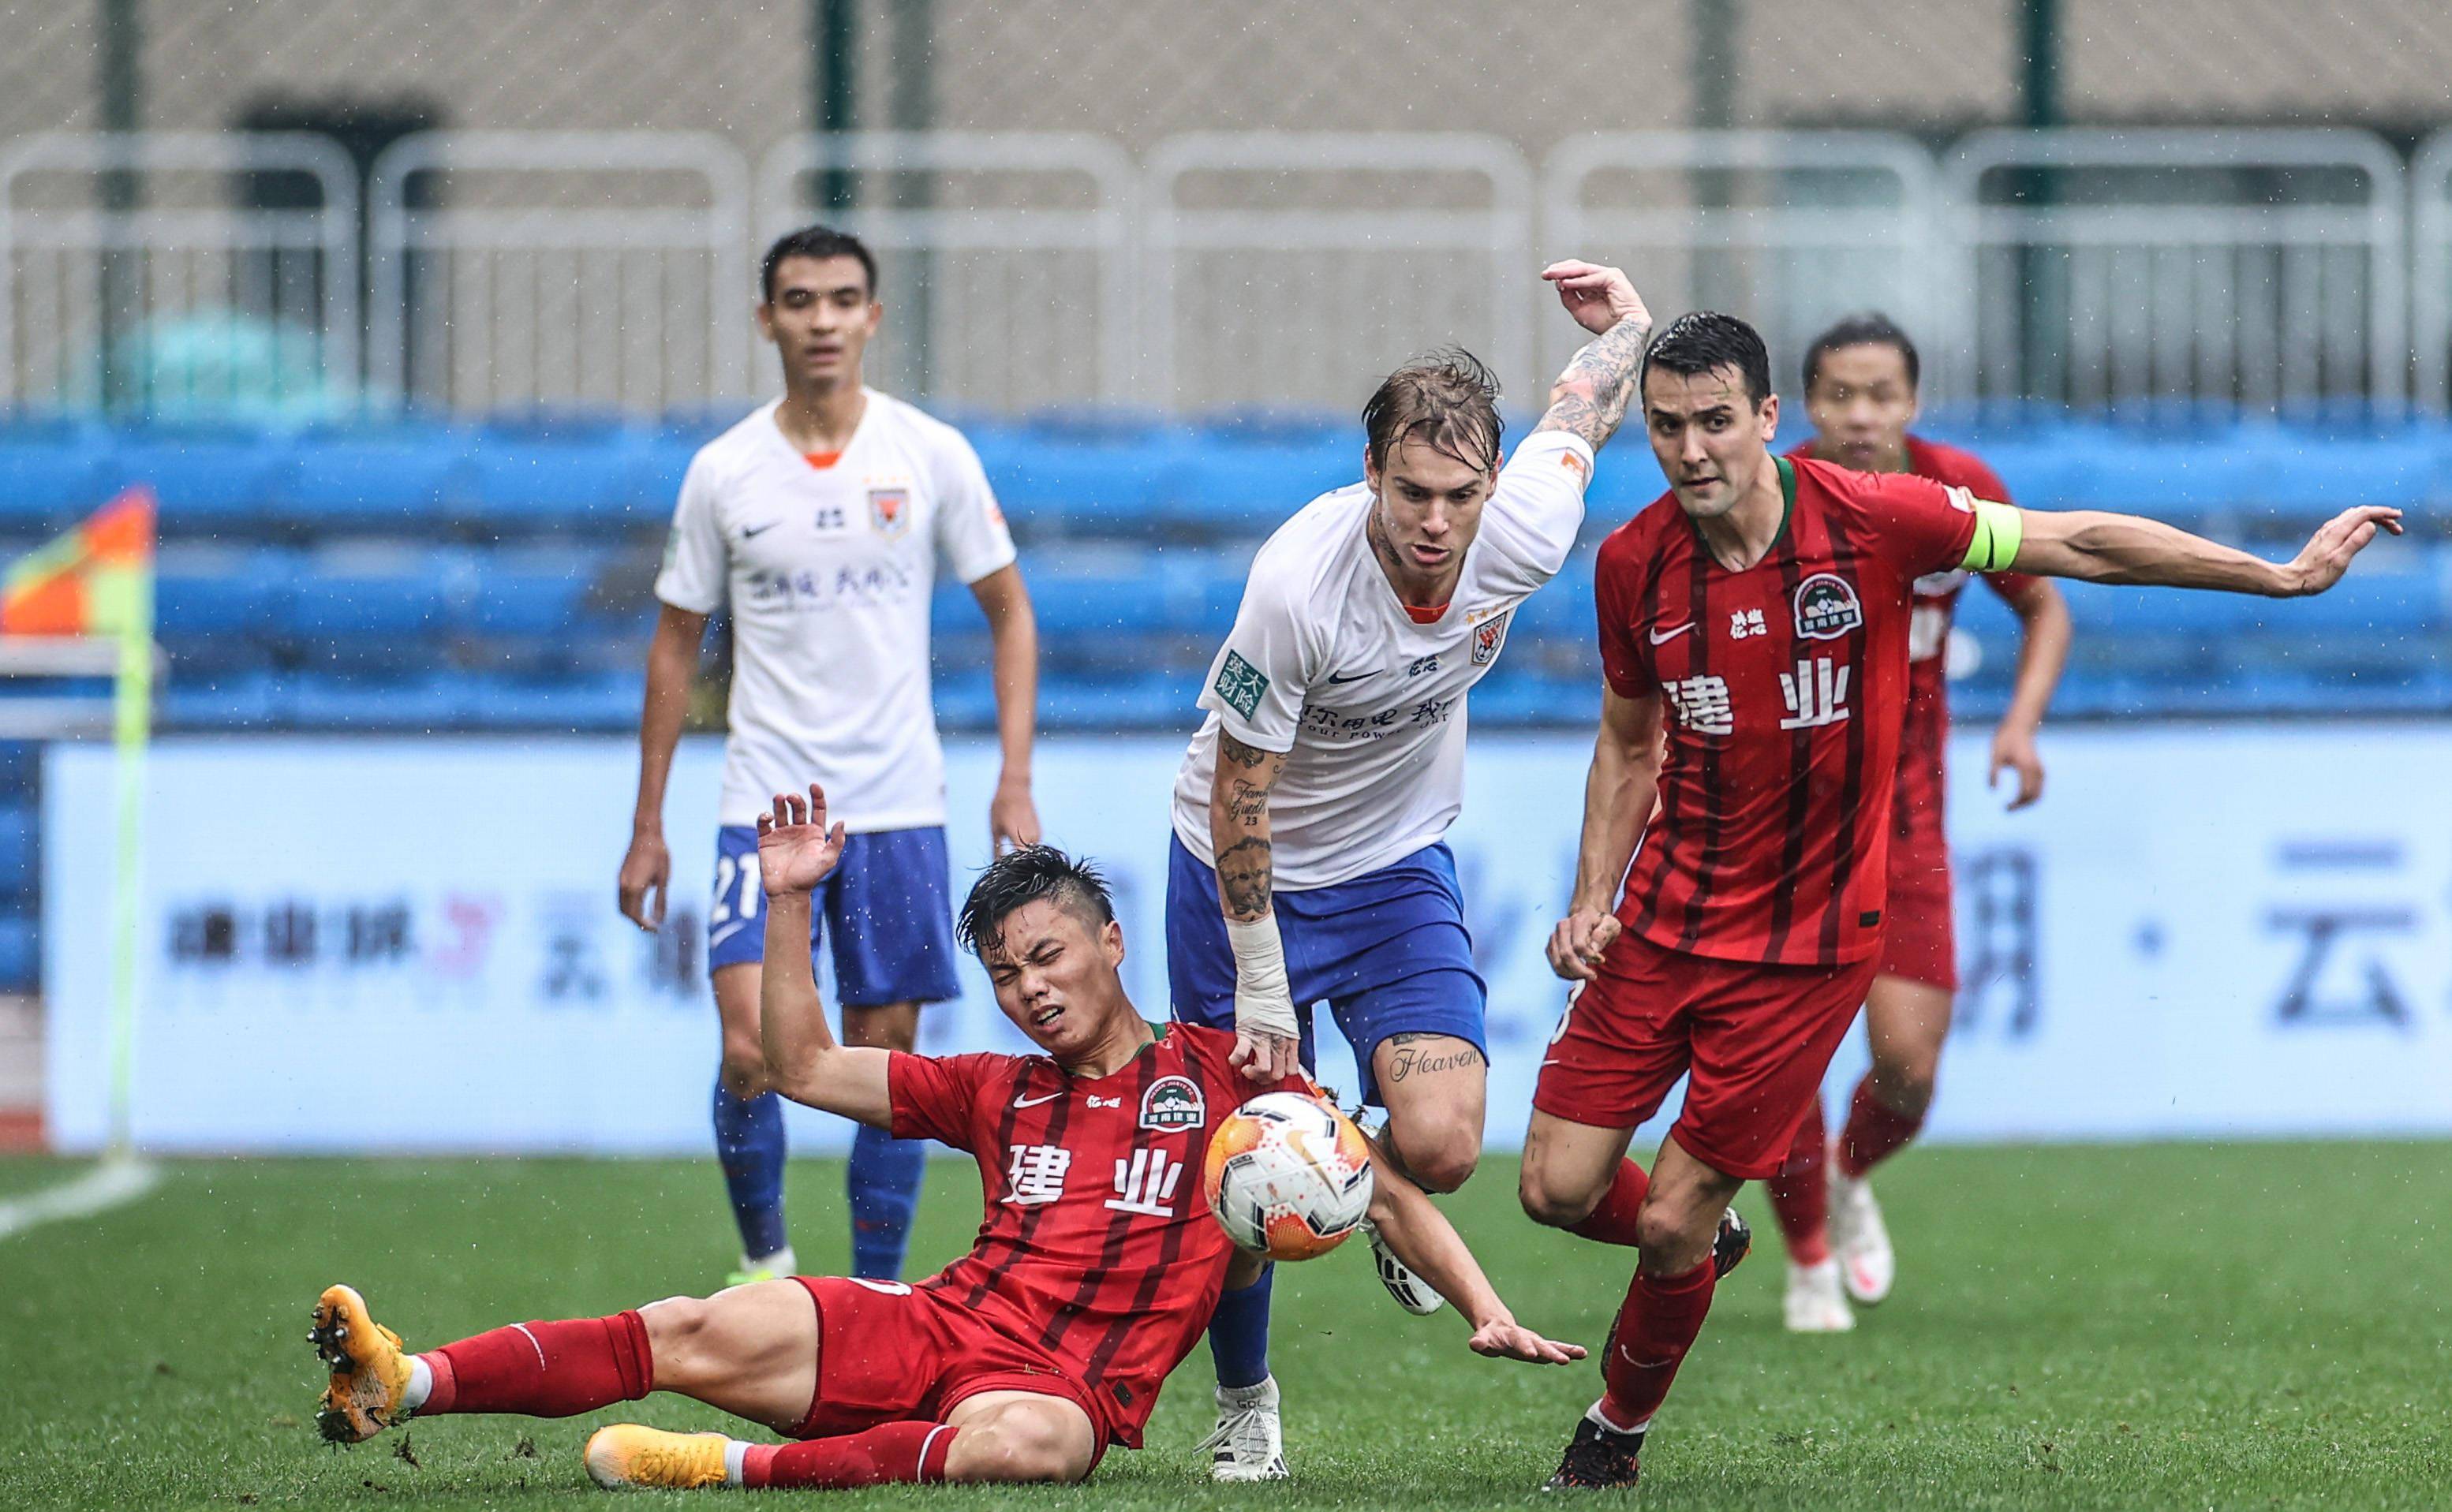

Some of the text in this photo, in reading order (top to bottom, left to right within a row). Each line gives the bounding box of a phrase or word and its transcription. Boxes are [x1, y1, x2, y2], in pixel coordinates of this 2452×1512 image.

[1662, 658, 1849, 734] 建业
[1244, 816, 1258, 827] 23
[712, 852, 761, 922] 21
[1390, 1048, 1480, 1083] Heaven
[1001, 1144, 1183, 1217] 建业
